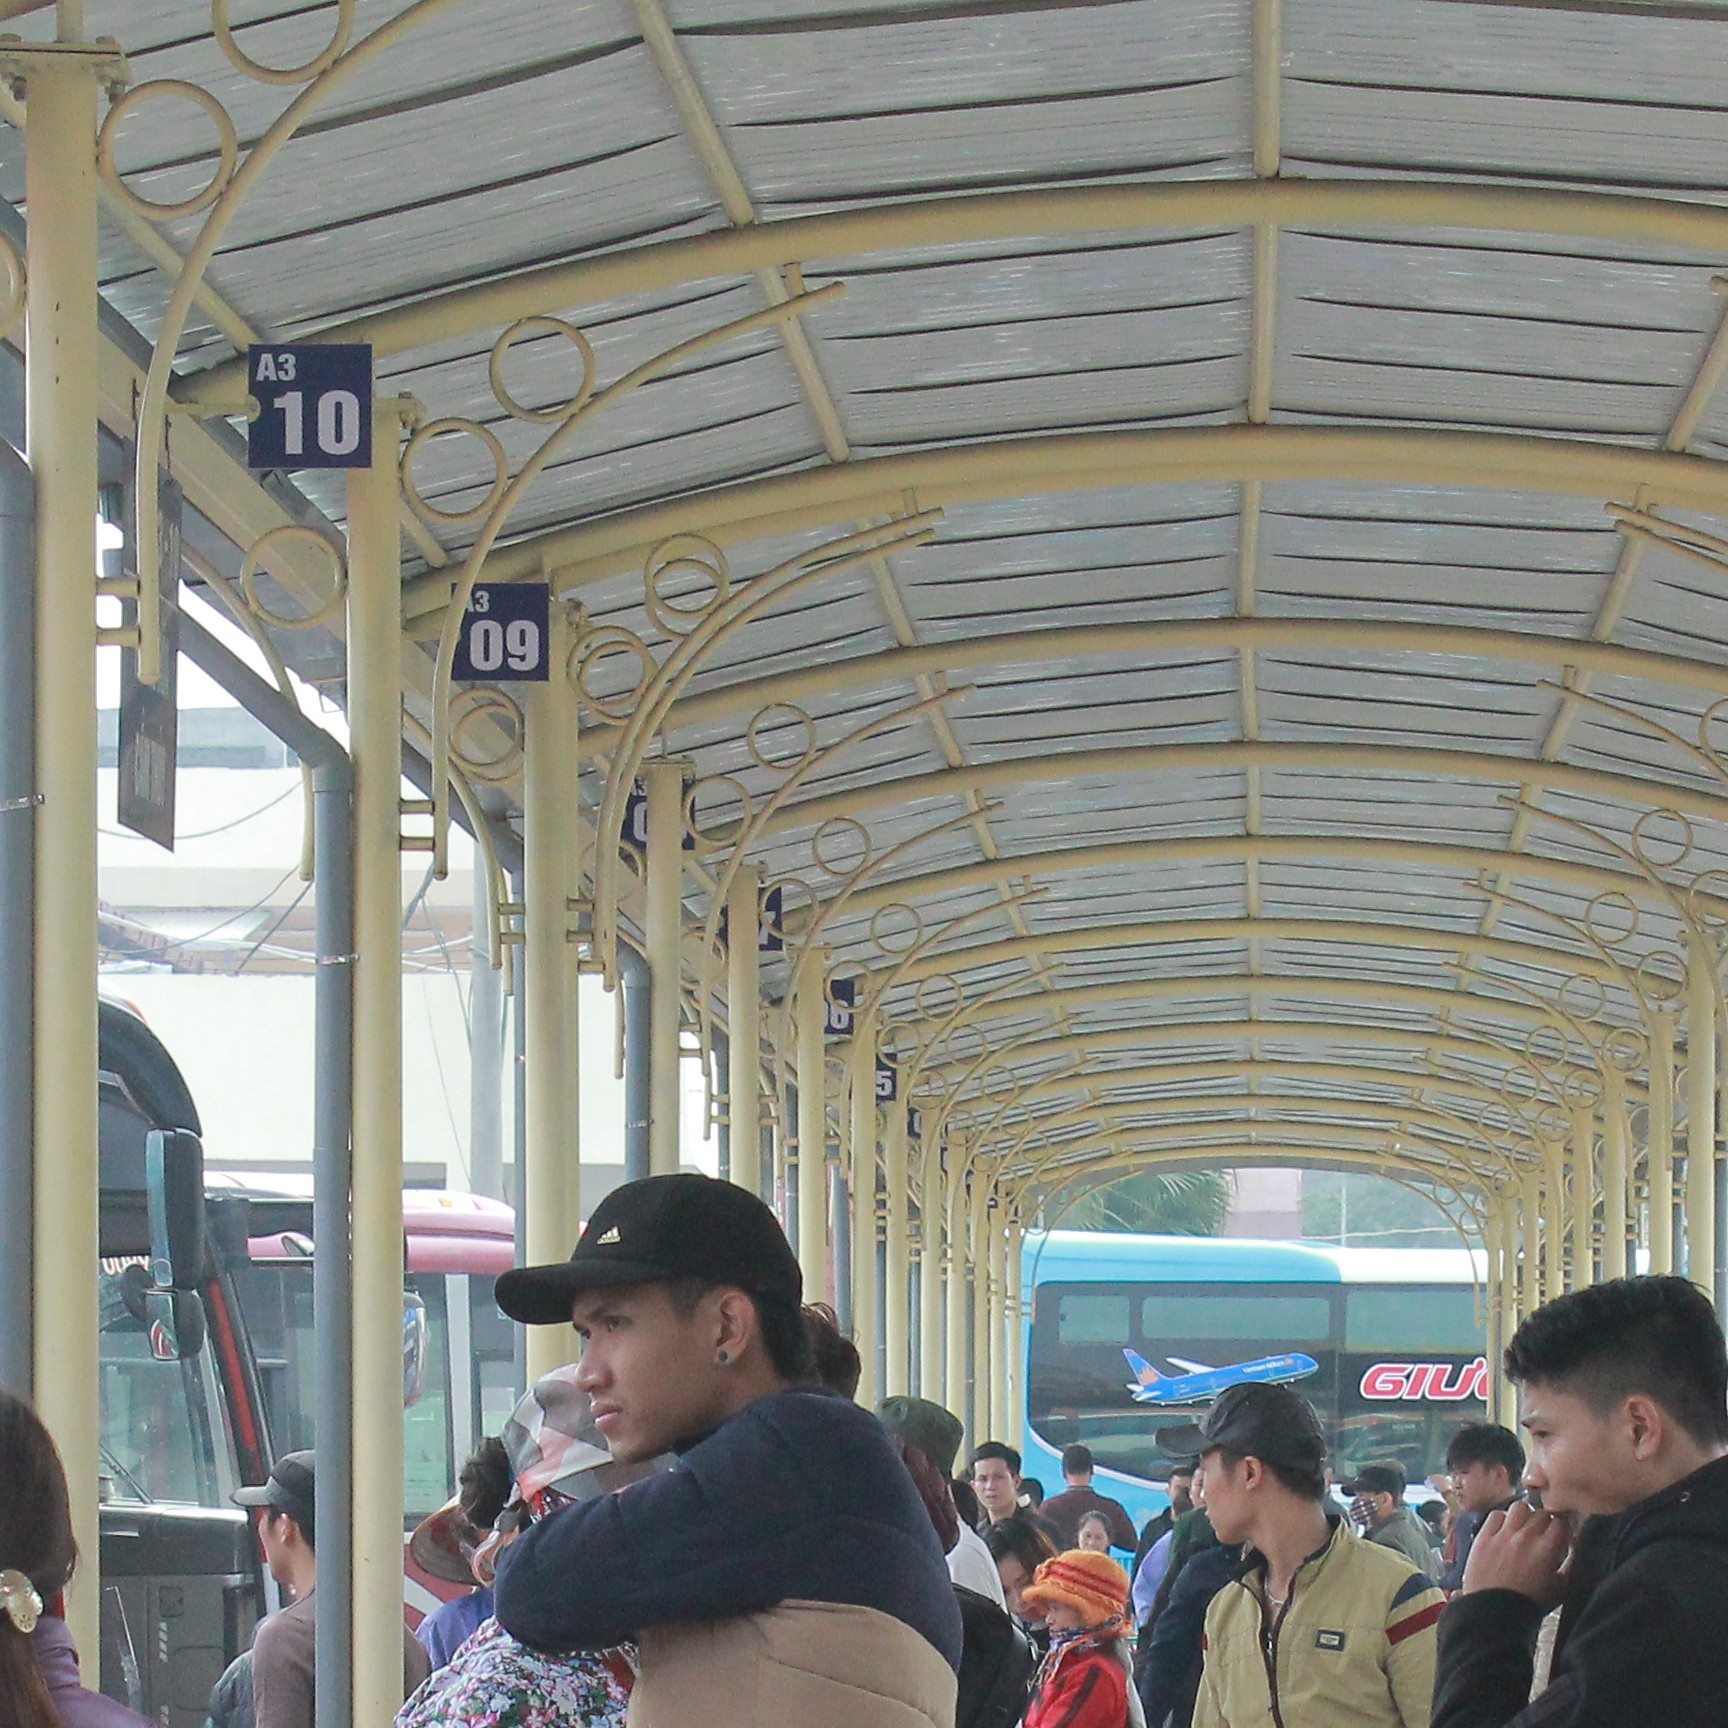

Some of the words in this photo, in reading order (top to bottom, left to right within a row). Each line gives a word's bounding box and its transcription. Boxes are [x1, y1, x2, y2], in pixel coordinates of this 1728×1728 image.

[256, 353, 297, 382] A3
[273, 389, 361, 456] 10
[469, 619, 540, 672] 09
